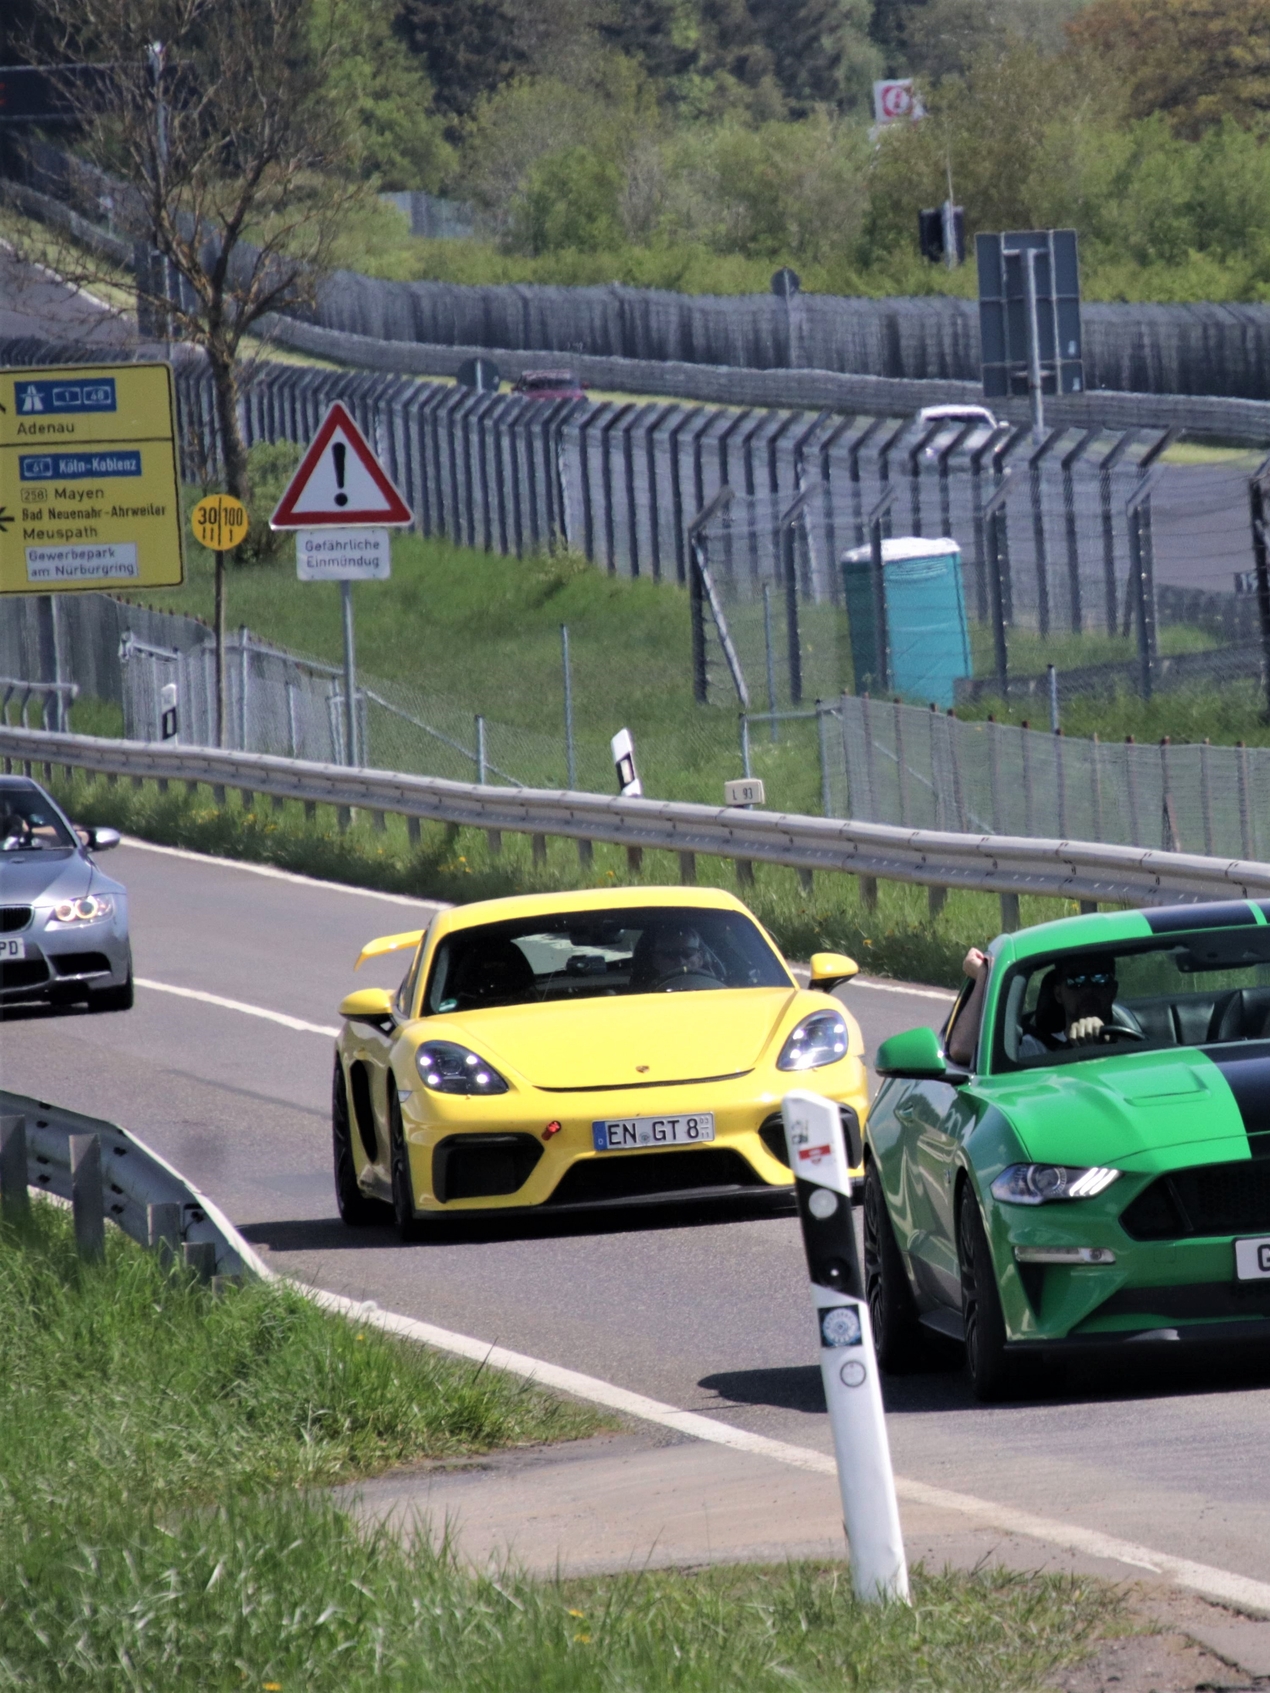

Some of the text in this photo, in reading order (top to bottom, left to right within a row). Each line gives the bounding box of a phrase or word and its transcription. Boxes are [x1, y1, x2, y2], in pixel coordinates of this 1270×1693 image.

[17, 421, 75, 435] Adenau
[59, 457, 137, 474] Köln-Koblenz
[23, 487, 105, 502] 258 Mayen
[22, 507, 43, 521] Bad
[197, 507, 243, 526] 30 100
[23, 525, 98, 541] Meuspath
[305, 539, 380, 552] Gefährliche
[29, 547, 115, 562] Gewerbepark
[306, 555, 380, 569] Einmündug
[31, 562, 135, 577] am Nürburgring
[742, 787, 753, 800] 93
[607, 1122, 637, 1145] EN
[652, 1119, 680, 1141] GT
[686, 1118, 699, 1139] 8
